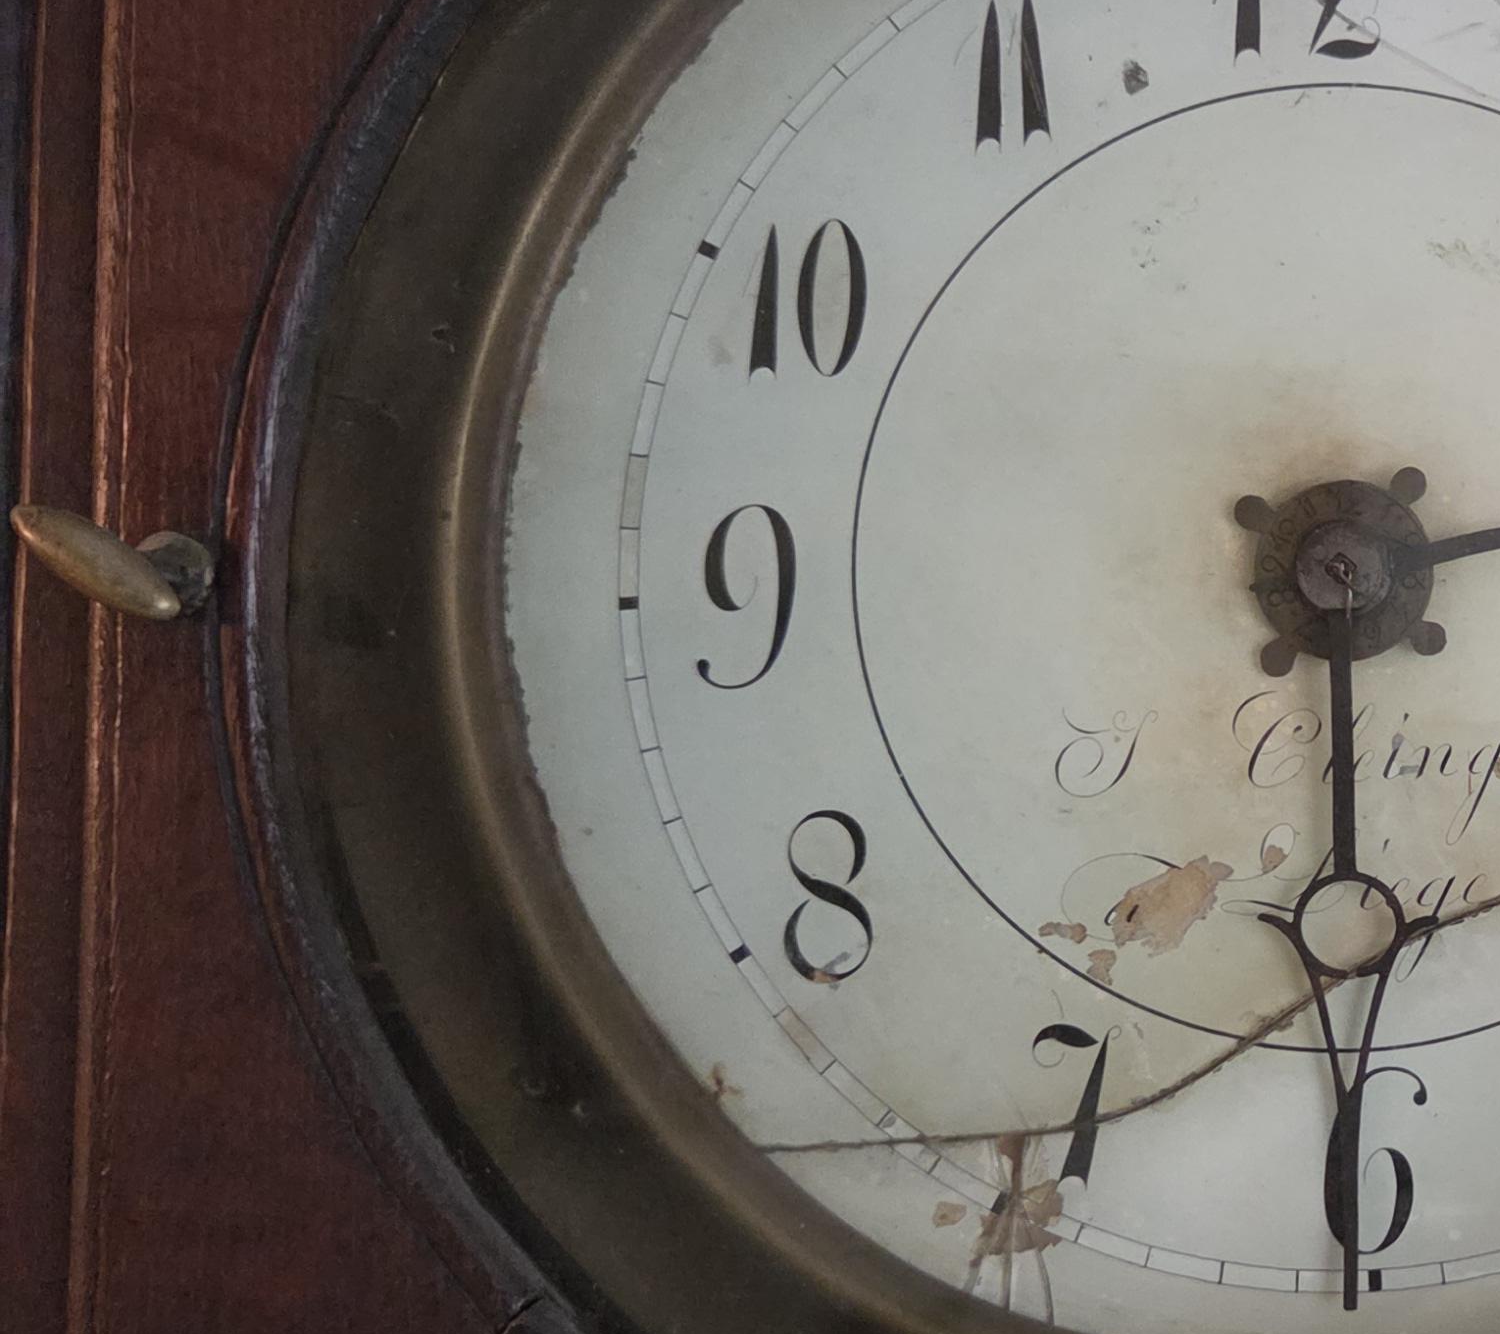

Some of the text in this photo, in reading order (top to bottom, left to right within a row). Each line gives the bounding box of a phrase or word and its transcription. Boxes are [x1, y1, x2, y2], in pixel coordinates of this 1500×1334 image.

[744, 218, 868, 384] 10
[696, 503, 798, 690] 9
[782, 809, 873, 984] 8
[1031, 1022, 1122, 1192] 7
[1323, 1065, 1428, 1255] 6
